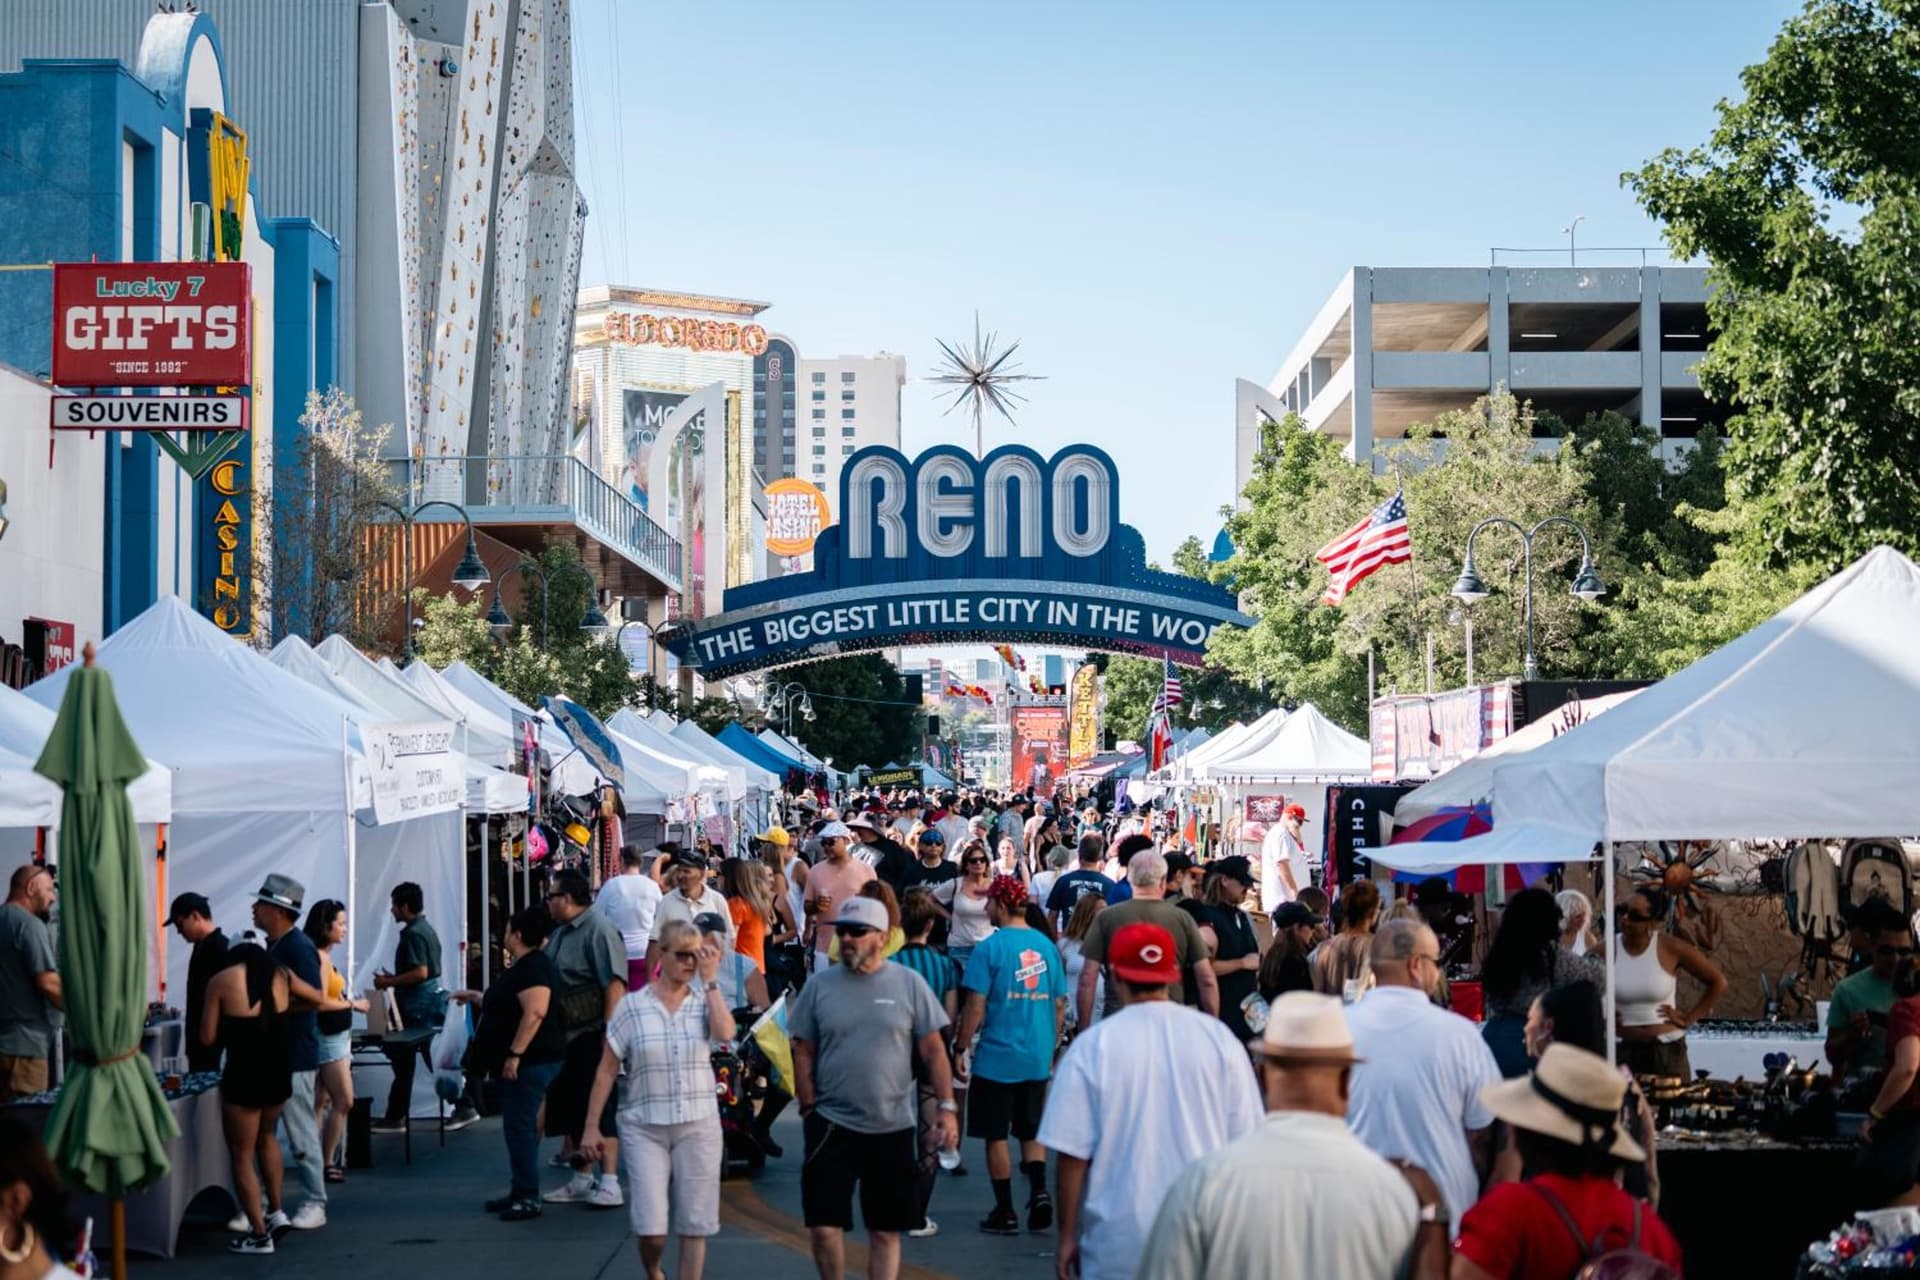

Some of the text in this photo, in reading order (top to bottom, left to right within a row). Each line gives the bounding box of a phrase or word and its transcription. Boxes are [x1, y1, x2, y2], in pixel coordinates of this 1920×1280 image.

[97, 277, 205, 301] Lucky 7
[66, 306, 238, 350] GIFTS
[68, 402, 229, 423] SOUVENIRS
[849, 454, 1111, 558] RENO
[211, 460, 244, 630] CASINO
[699, 627, 755, 661] THE
[764, 605, 878, 645] BIGGEST
[888, 598, 970, 627] LITTLE
[978, 597, 1041, 623] CITY
[1047, 600, 1078, 626] IN
[1087, 604, 1141, 634] THE
[1078, 673, 1093, 752] KETTLE
